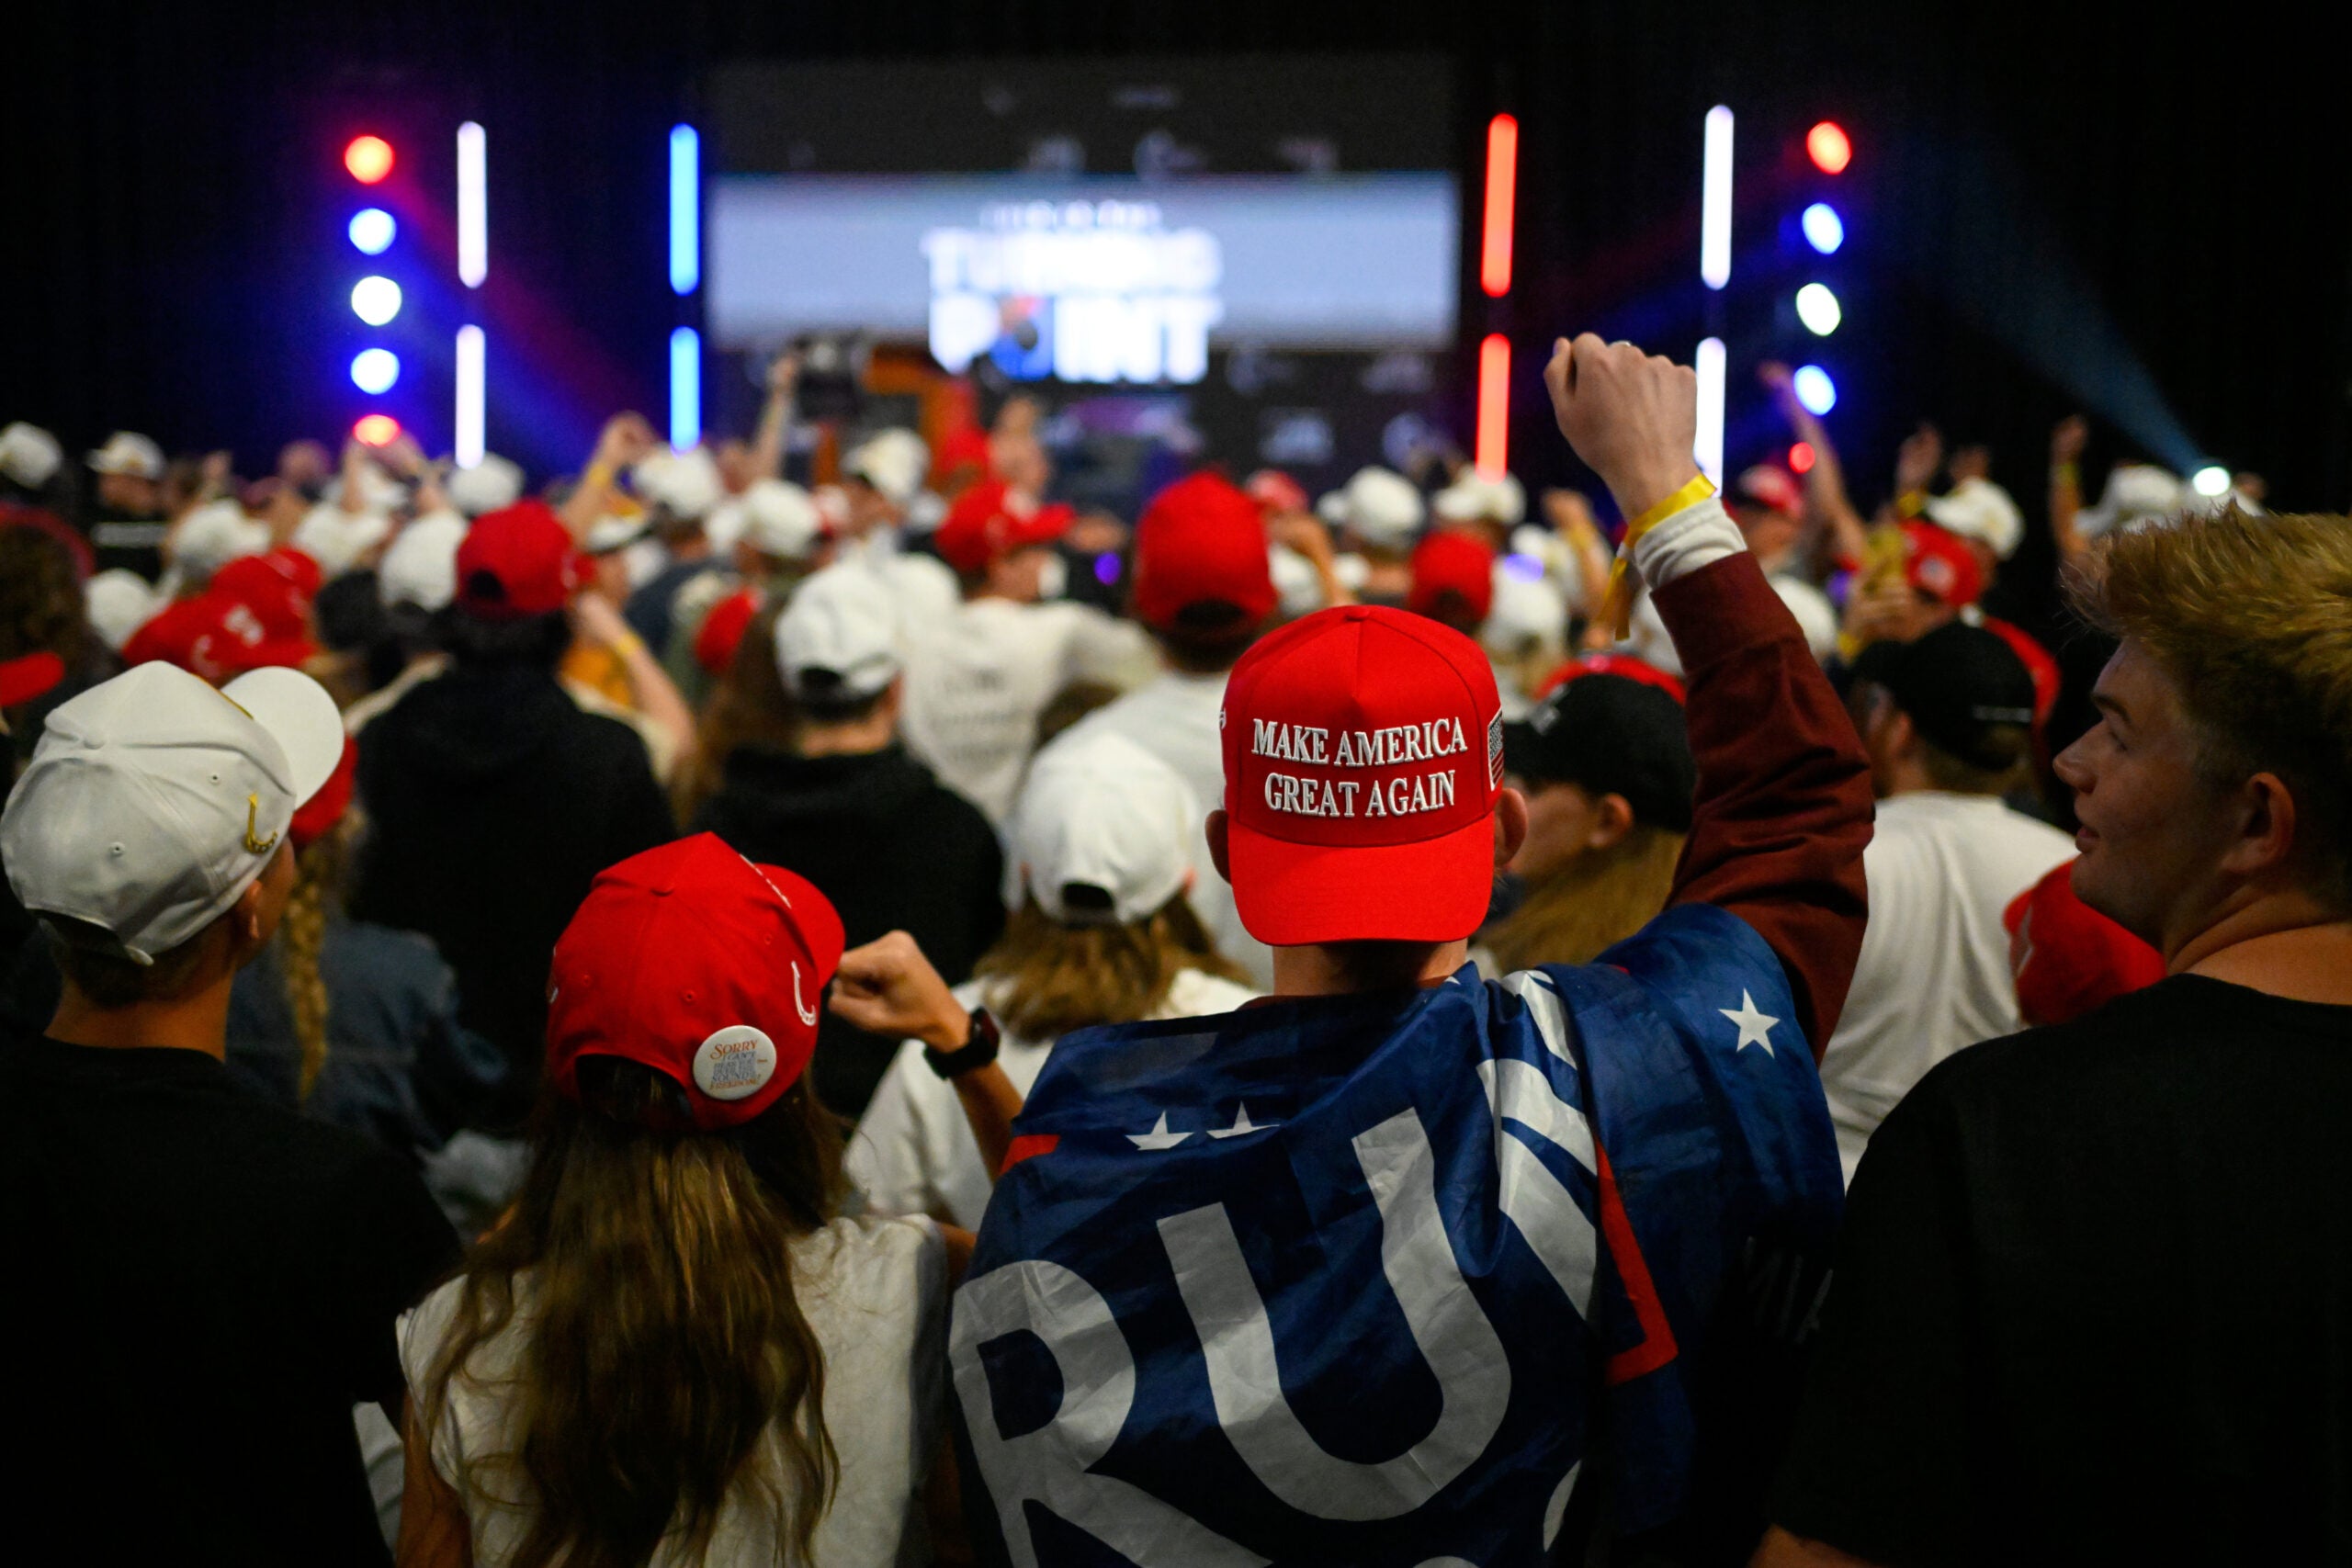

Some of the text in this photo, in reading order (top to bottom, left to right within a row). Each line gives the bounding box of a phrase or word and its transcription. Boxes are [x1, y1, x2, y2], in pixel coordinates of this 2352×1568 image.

[1251, 718, 1329, 765] MAKE
[1333, 716, 1468, 767] AMERICA
[1264, 770, 1455, 818] GREAT AGAIN
[709, 1039, 758, 1060] SORRY
